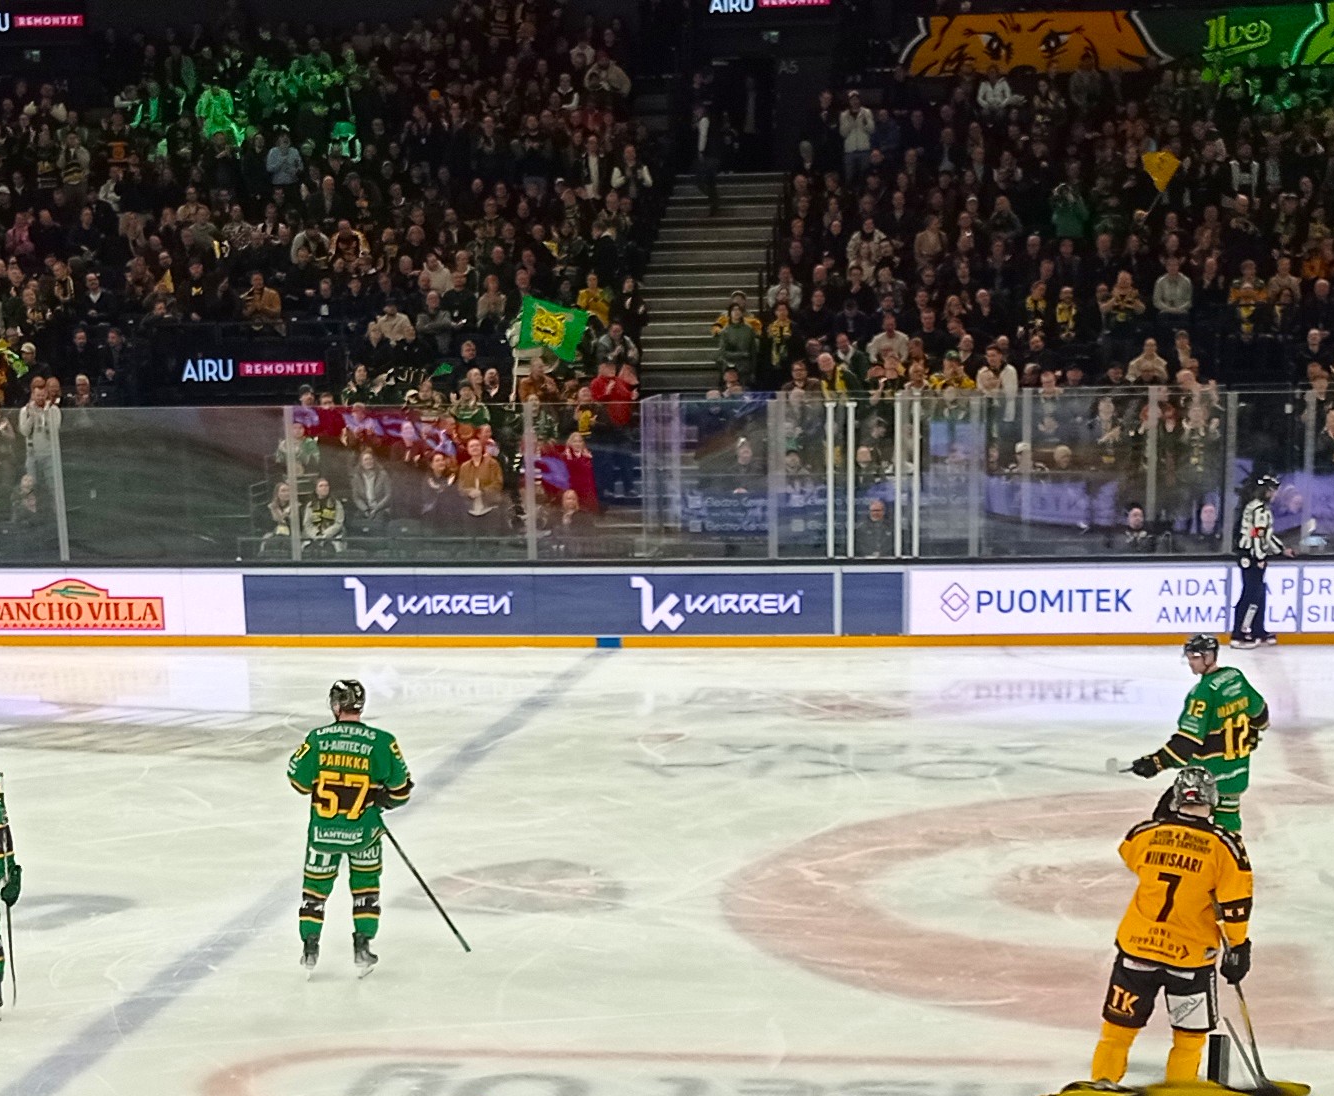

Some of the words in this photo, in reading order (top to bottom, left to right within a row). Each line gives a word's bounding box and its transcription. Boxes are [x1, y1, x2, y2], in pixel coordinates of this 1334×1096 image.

[18, 15, 79, 27] REMONTIT
[245, 362, 319, 375] REMONTIT
[89, 602, 159, 622] VILLA
[397, 592, 513, 616] KARREN
[685, 591, 803, 616] KARREN
[976, 589, 1132, 614] PUOMITEK
[1223, 713, 1251, 760] 12
[319, 753, 370, 770] PARIKKA
[315, 770, 371, 820] 57
[1144, 850, 1204, 873] NIINISAARI
[1157, 871, 1183, 922] 7
